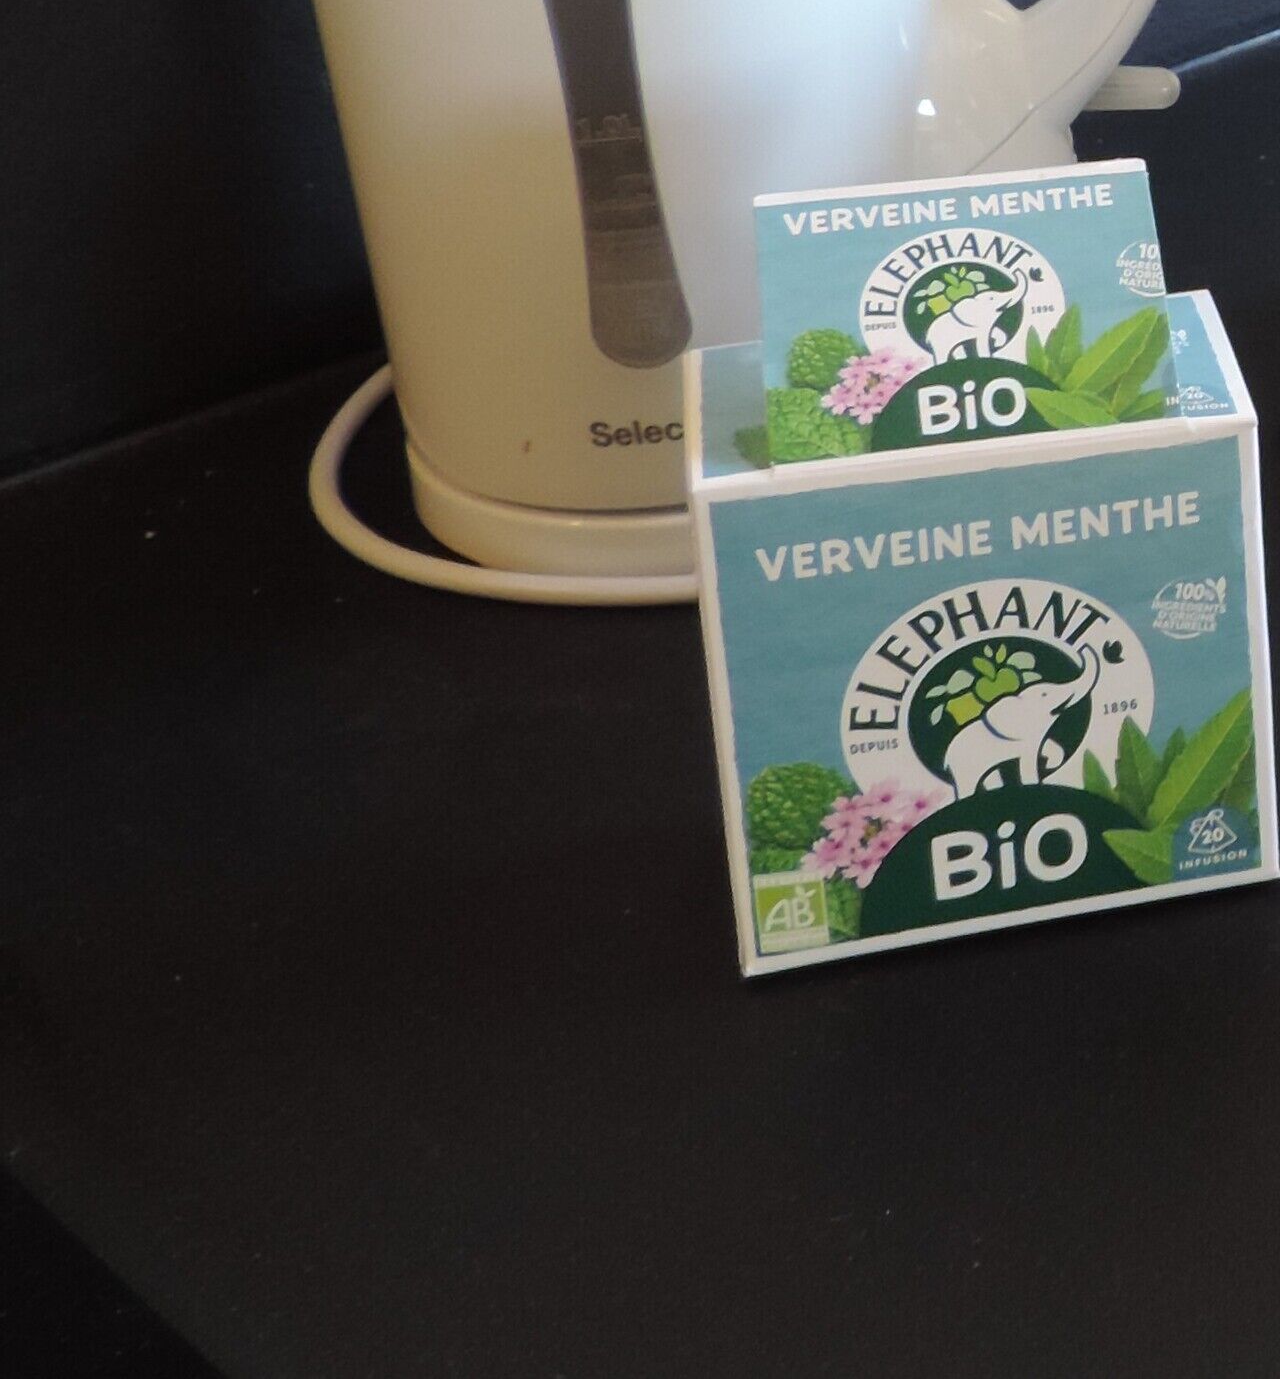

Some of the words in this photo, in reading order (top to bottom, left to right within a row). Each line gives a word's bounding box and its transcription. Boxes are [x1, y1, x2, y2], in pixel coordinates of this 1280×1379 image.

[783, 197, 958, 237] VERVEINE
[970, 182, 1114, 219] MENTHE
[863, 232, 1033, 319] ELEPHANT
[864, 321, 897, 332] DEPUIS
[589, 420, 684, 447] Selec
[917, 376, 1027, 437] BiO
[755, 520, 994, 583] VERVEINE
[1011, 490, 1201, 551] MENTHE
[848, 586, 1112, 733] ELEPHANT
[849, 737, 900, 756] DEPUIS
[1102, 698, 1139, 716] 1896
[931, 812, 1089, 903] BiO
[1179, 849, 1248, 871] INFUSION
[1202, 827, 1225, 845] 20
[765, 896, 816, 932] AB
